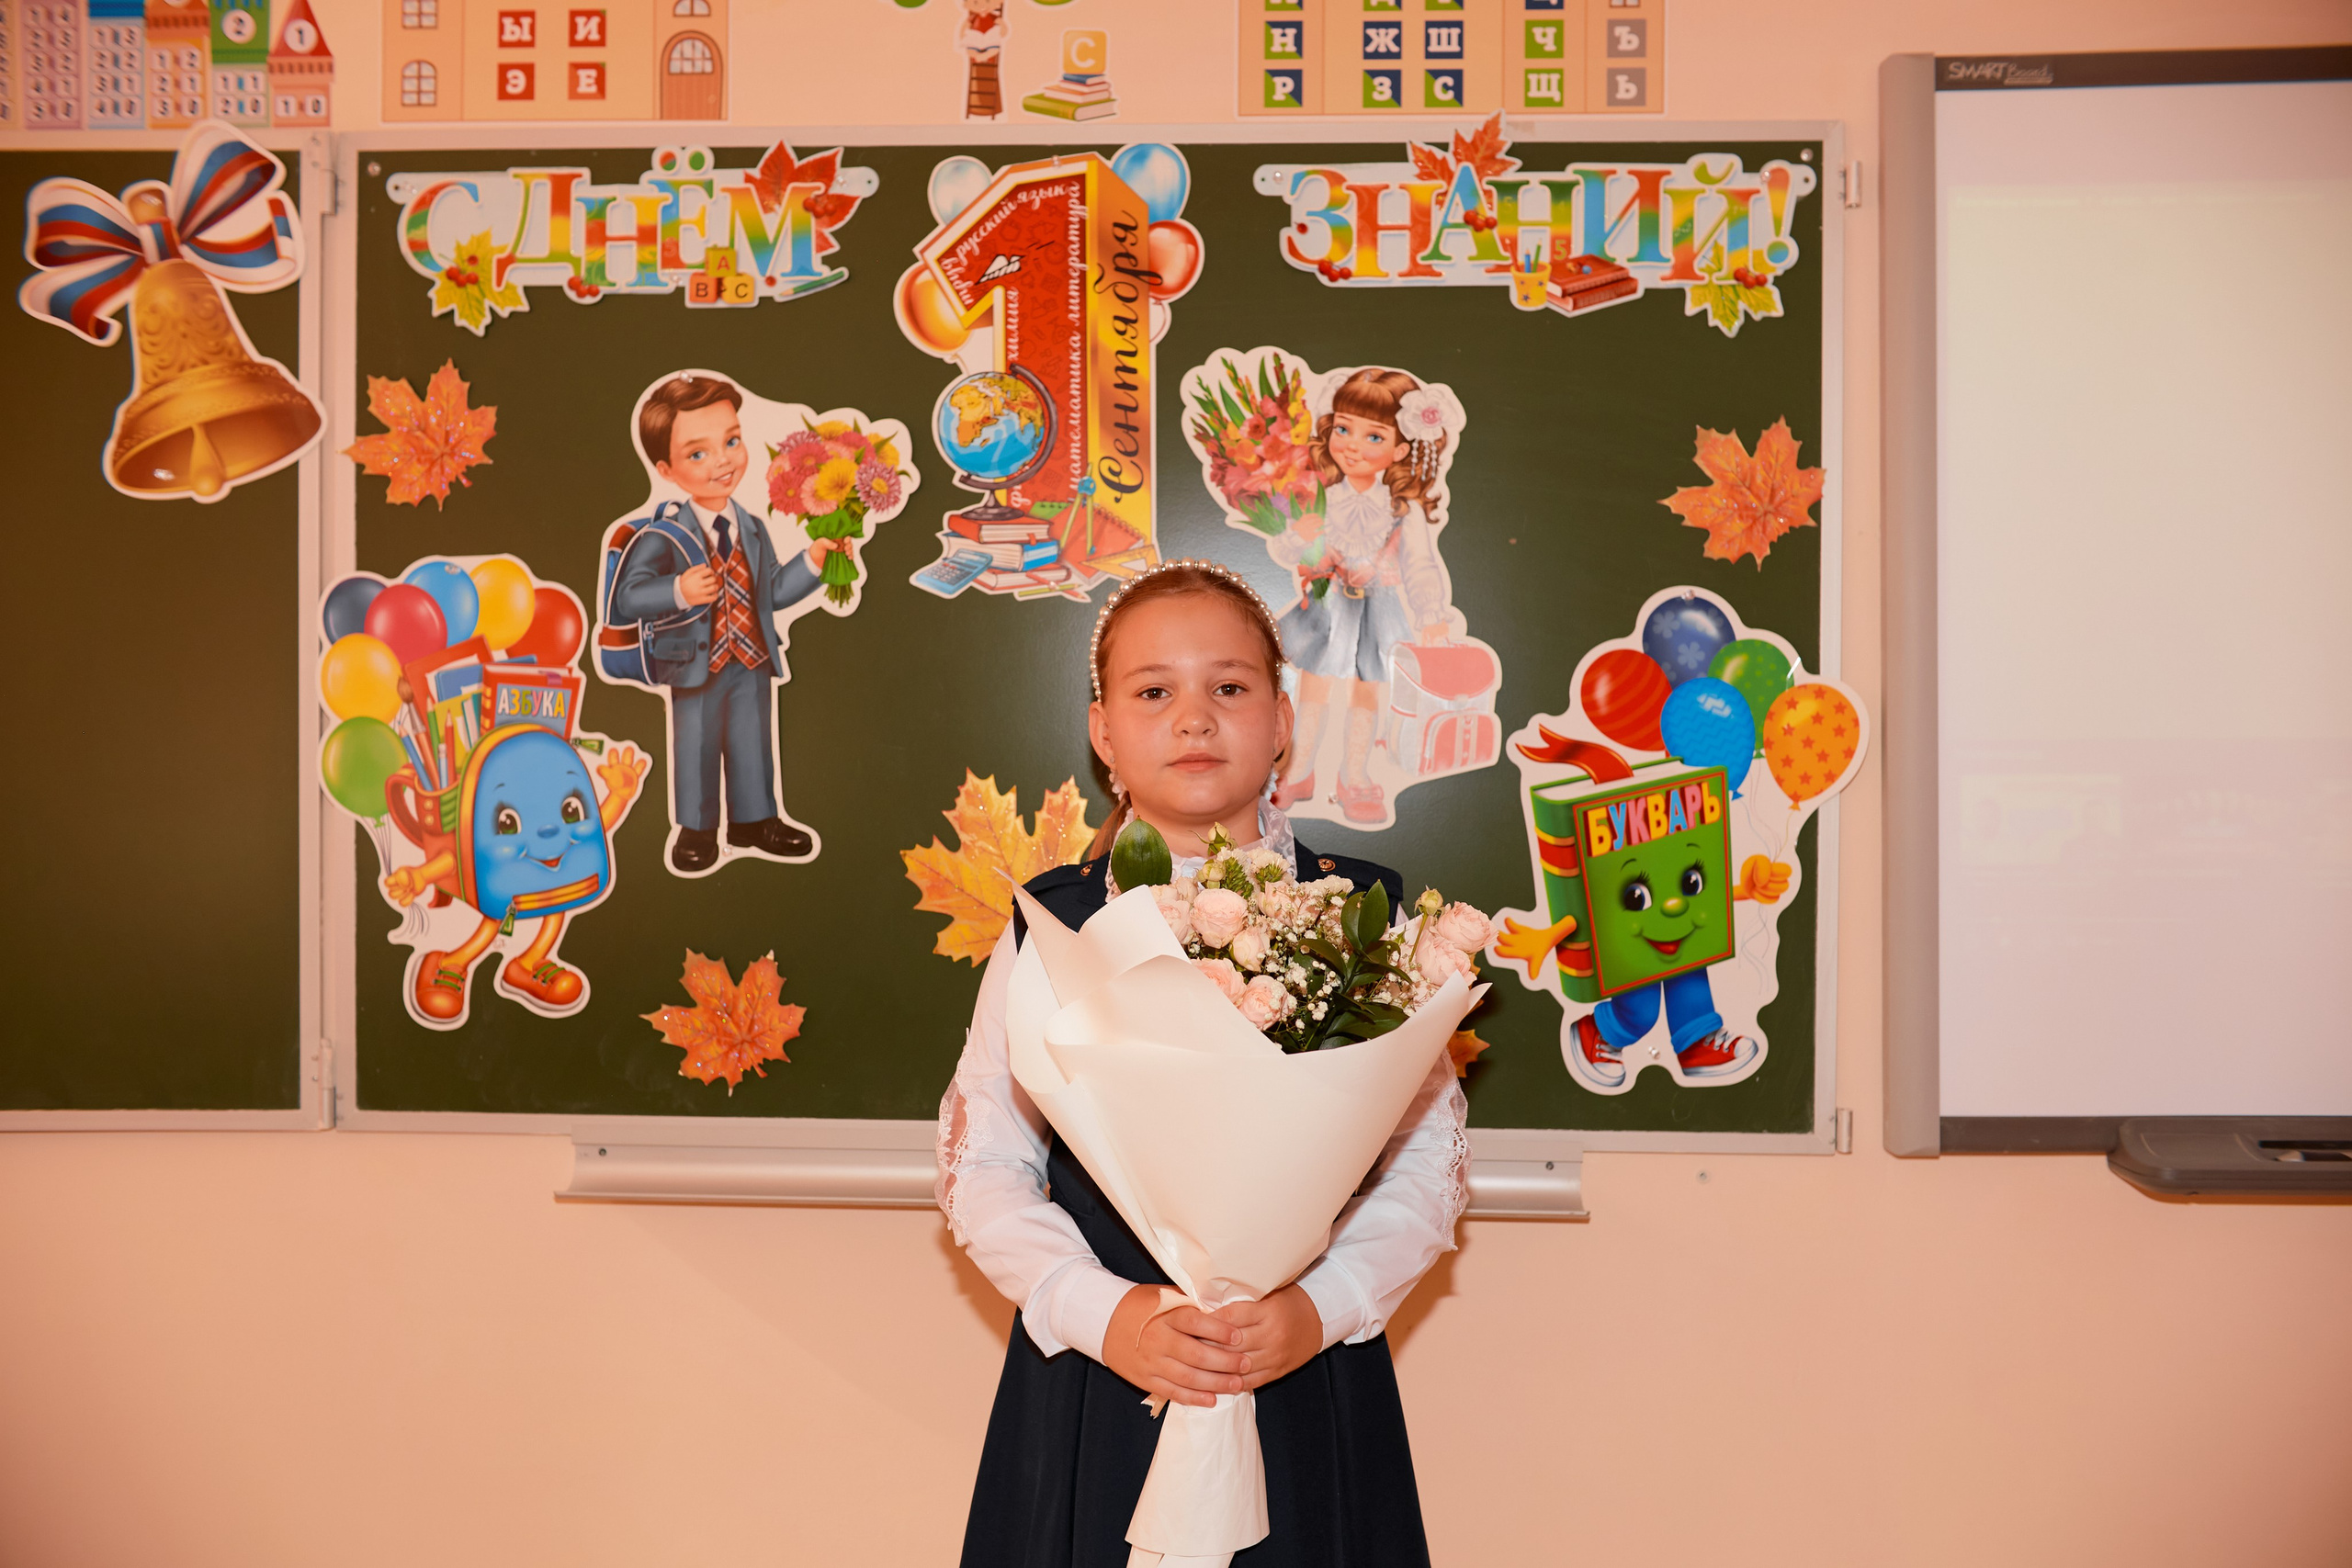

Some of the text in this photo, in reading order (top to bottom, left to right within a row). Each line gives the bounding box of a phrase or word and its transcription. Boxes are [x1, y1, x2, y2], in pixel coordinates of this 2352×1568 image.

[502, 16, 601, 42] Ы И
[1271, 26, 1639, 53] Н Ж Ш Ч Ъ
[505, 69, 598, 95] Э Е
[1272, 73, 1638, 102] Р З С Щ Ь
[1949, 62, 2007, 79] SMART
[406, 150, 825, 288] С ДНЁМ
[956, 185, 1068, 266] русский язык
[1068, 181, 1089, 326] литература
[1287, 161, 1792, 281] ЗНАНИЙ!
[1007, 287, 1019, 360] химия
[1093, 209, 1163, 503] Сентября
[498, 688, 565, 717] АЗБУКА
[1583, 782, 1721, 857] БУКВАРЬ
